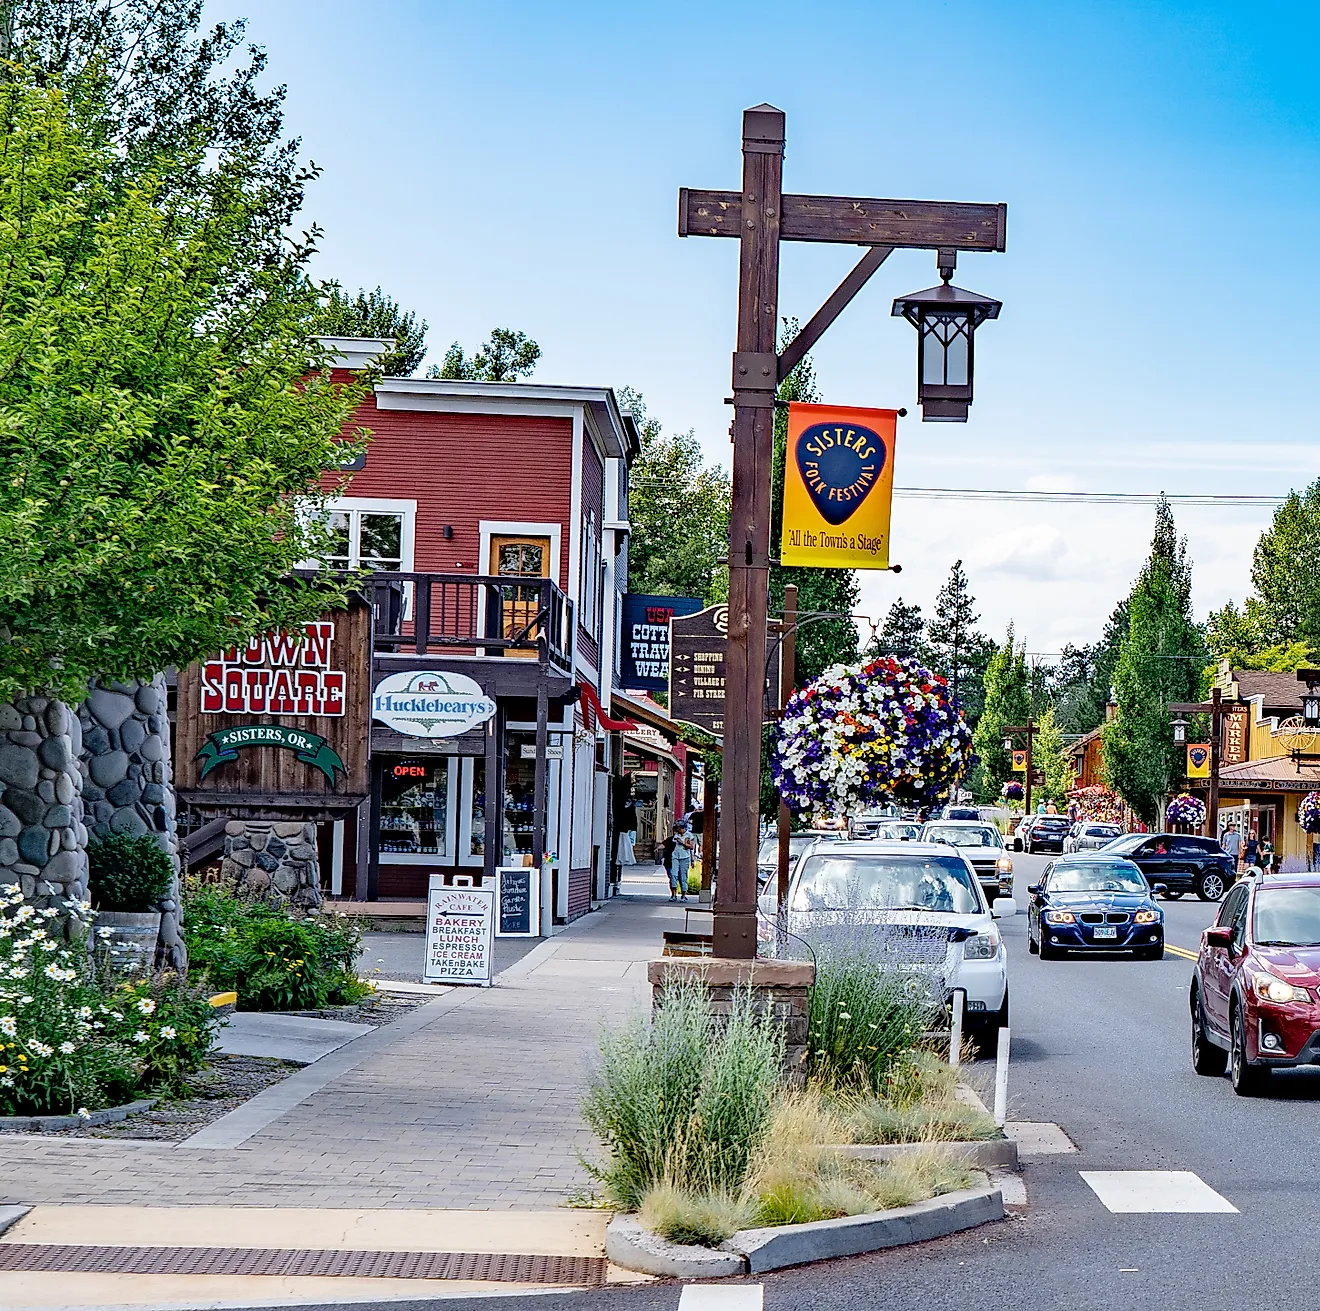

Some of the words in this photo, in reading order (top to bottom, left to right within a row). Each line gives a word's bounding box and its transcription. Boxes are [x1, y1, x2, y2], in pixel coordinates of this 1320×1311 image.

[806, 428, 876, 459] SISTERS
[805, 461, 828, 495] FOLK
[828, 464, 875, 502] FESTIVAL
[803, 530, 817, 547] the
[819, 531, 848, 549] Town's
[849, 538, 855, 549] a
[646, 606, 675, 623] USA
[693, 653, 723, 662] SHOPPING
[635, 661, 670, 678] WEA
[693, 665, 715, 674] DINING
[693, 677, 720, 687] VILLAGE
[200, 660, 347, 717] SQUARE
[693, 689, 704, 698] FIR
[705, 690, 726, 699] STREE
[375, 694, 485, 719] Hucklebearys
[229, 728, 285, 744] SISTERS,
[287, 732, 307, 749] OR
[1227, 713, 1242, 762] MARKET
[393, 765, 425, 777] OPEN
[435, 893, 489, 911] RAINWATER
[435, 918, 485, 927] BAKERY
[432, 926, 486, 935] BREAKFAST
[439, 935, 479, 943] LUNCH
[432, 943, 485, 951] ESPRESSO
[451, 951, 483, 959] CREAM
[431, 959, 485, 968] TAKEnBAKE
[440, 968, 474, 976] PIZZA
